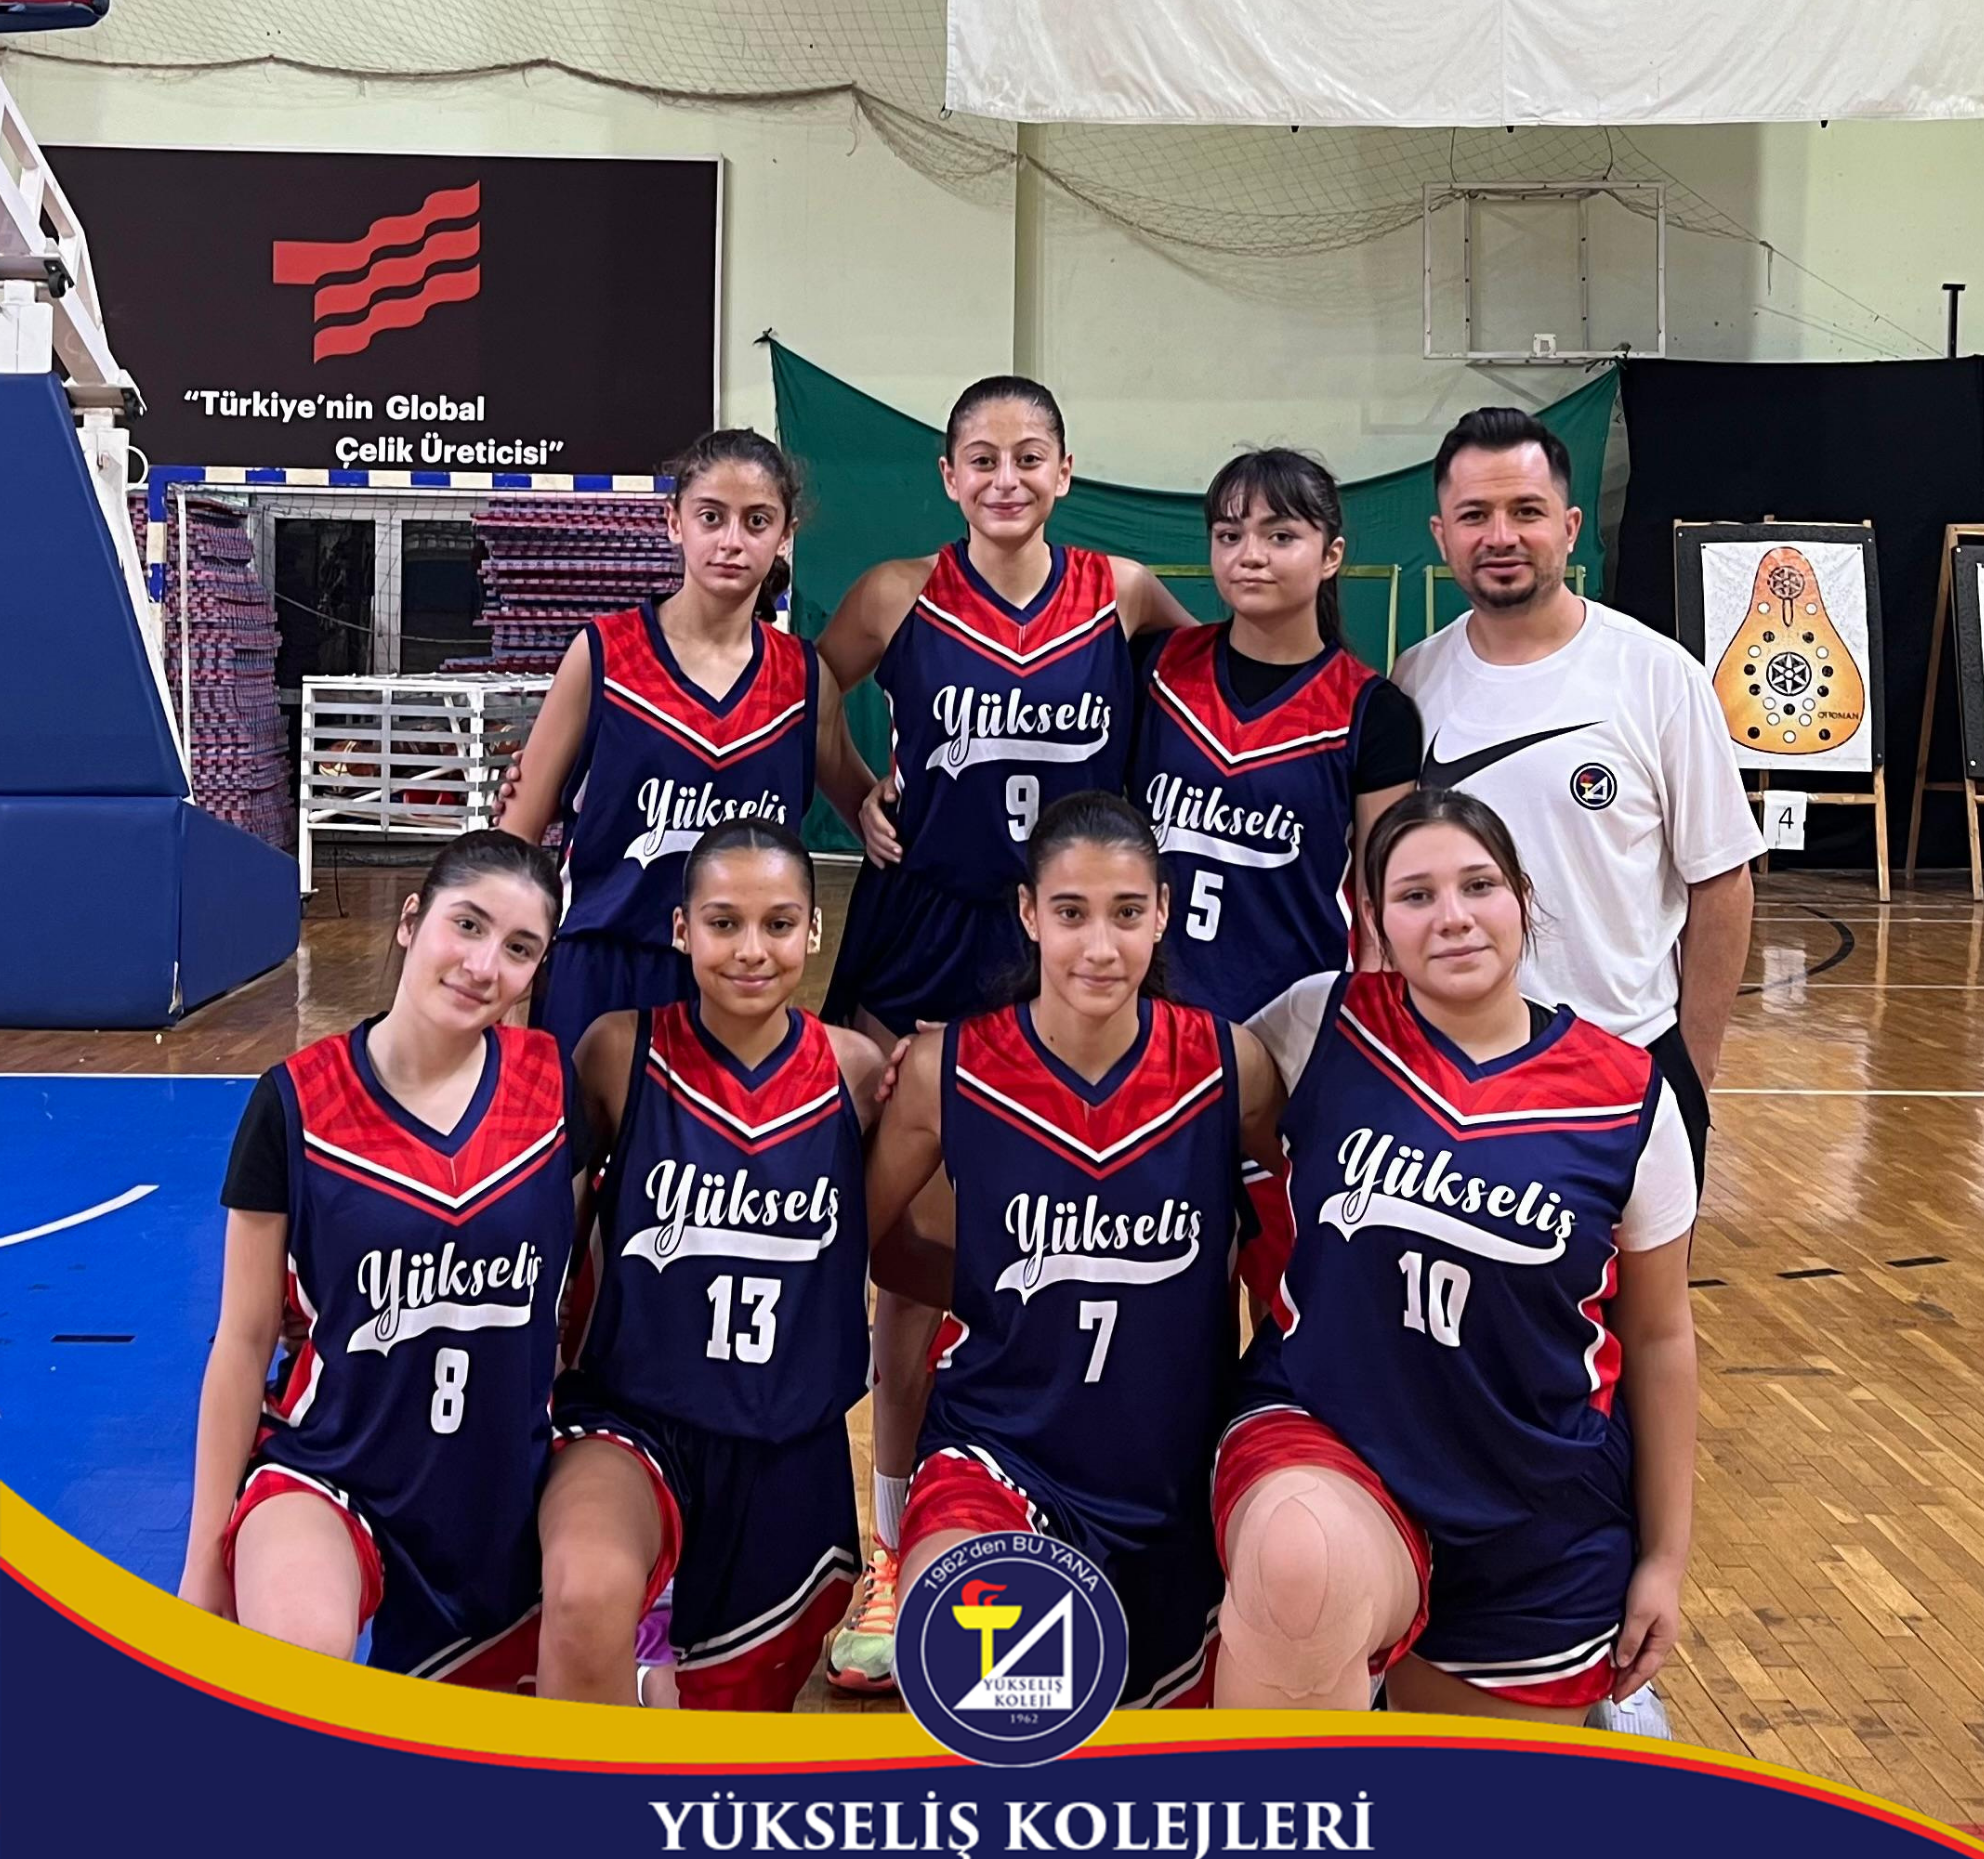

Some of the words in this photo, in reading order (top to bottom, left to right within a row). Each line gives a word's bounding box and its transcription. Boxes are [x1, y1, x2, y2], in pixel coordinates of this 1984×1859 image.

[386, 395, 485, 422] Global
[335, 436, 413, 469] Çelik
[420, 432, 564, 465] Üreticisi”
[1005, 774, 1040, 842] 9
[1778, 806, 1795, 830] 4
[1185, 869, 1224, 942] 5
[1337, 1128, 1577, 1256] Yükseliş
[1005, 1193, 1203, 1289] Yükseliş
[706, 1275, 782, 1365] 13
[1398, 1250, 1471, 1348] 10
[1079, 1300, 1118, 1383] 7
[430, 1347, 469, 1434] 8
